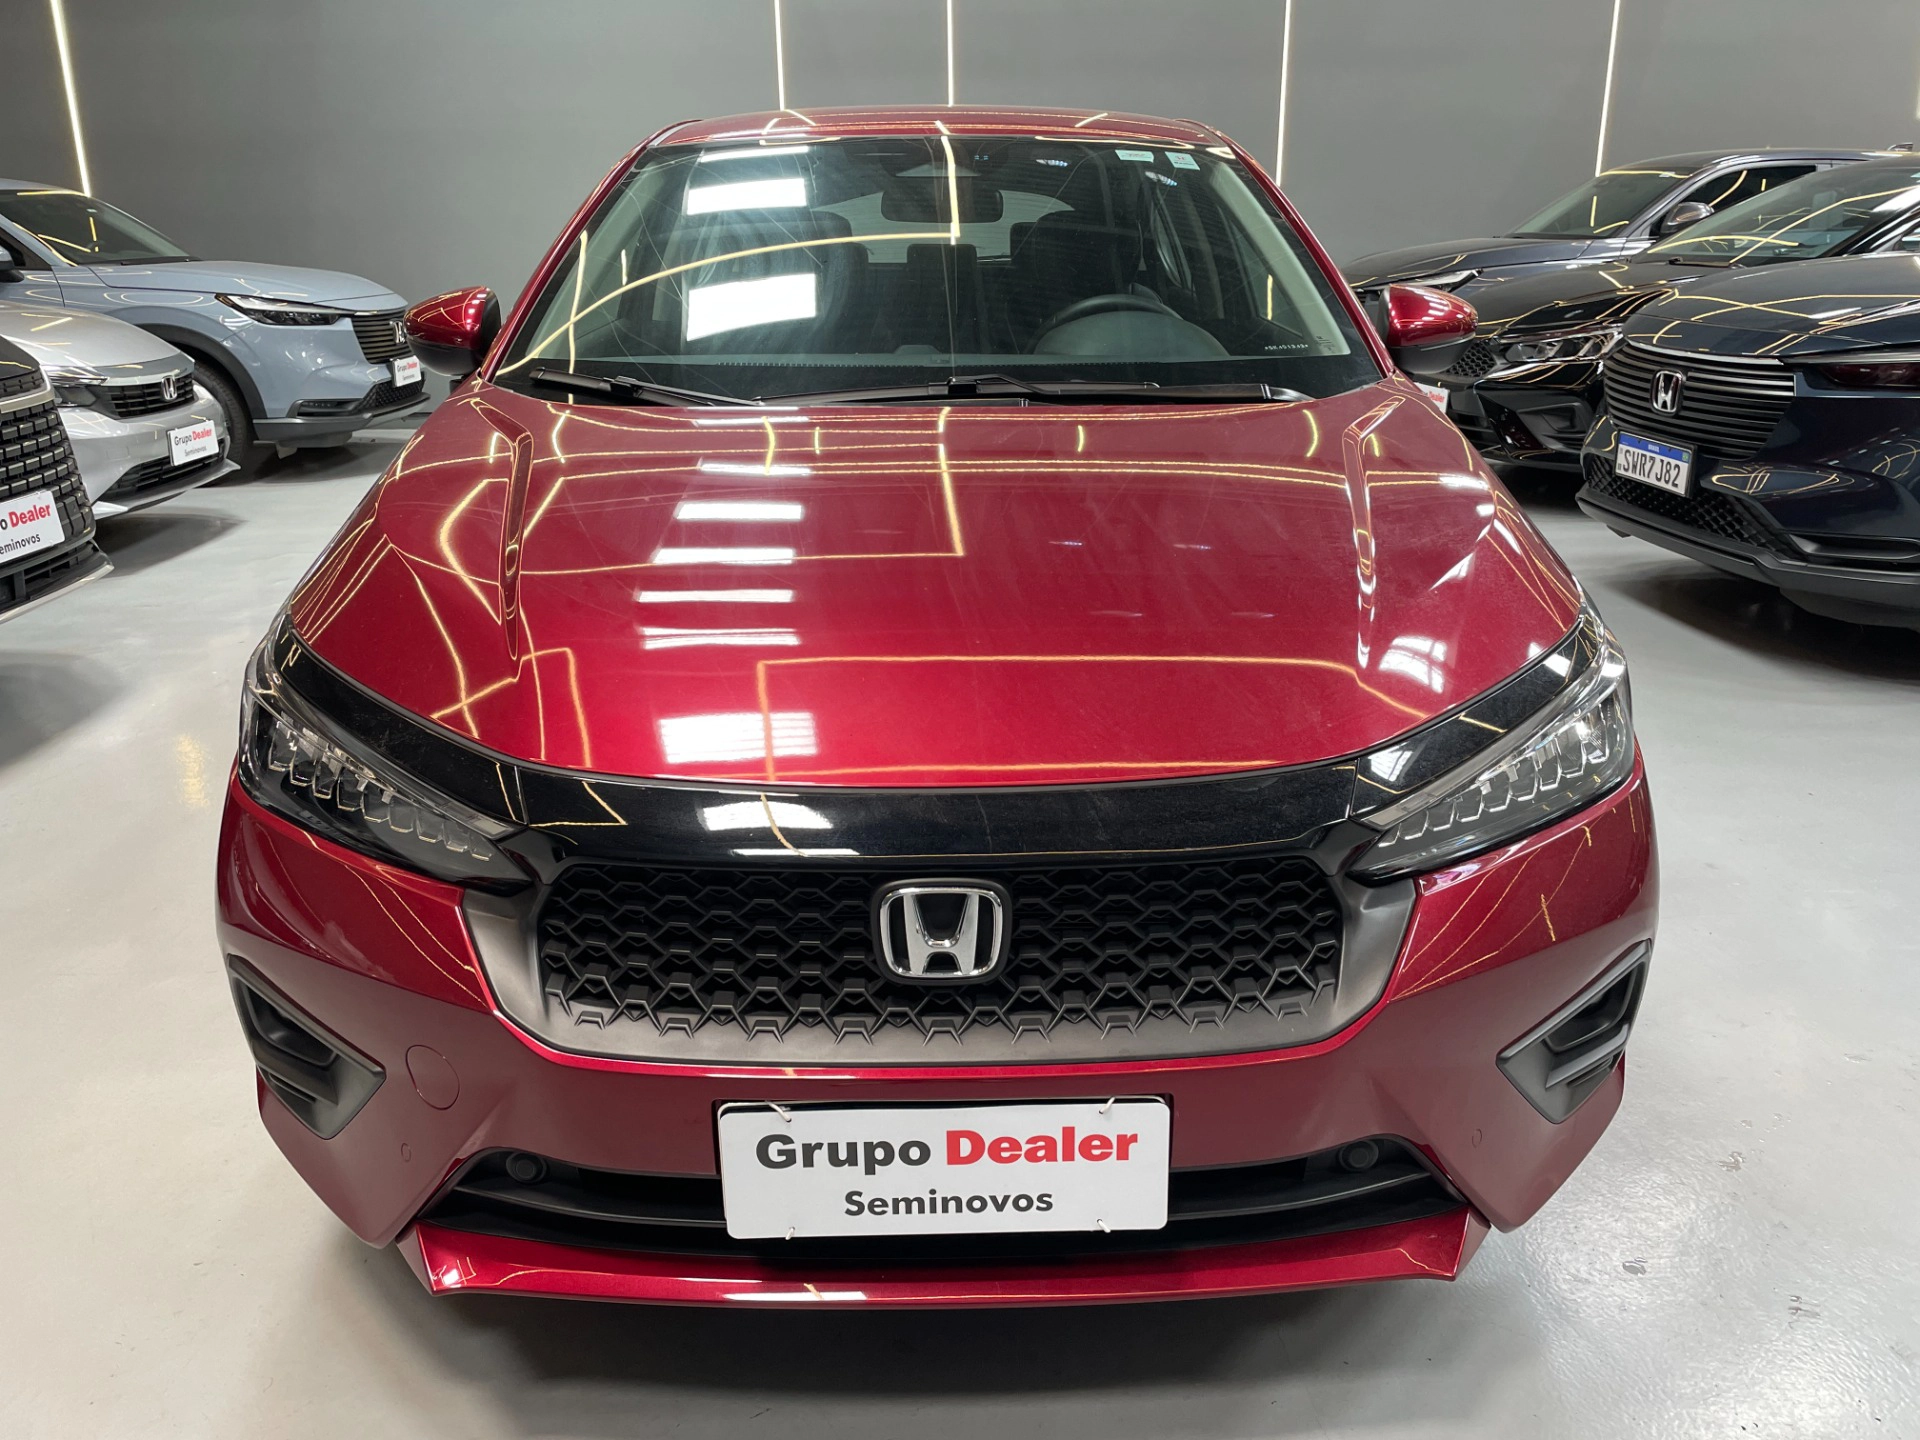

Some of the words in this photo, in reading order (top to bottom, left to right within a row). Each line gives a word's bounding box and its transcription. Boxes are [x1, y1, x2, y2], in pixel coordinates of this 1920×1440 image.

[174, 434, 192, 446] Grupo
[192, 427, 212, 440] Dealer
[1623, 449, 1681, 488] SWR7J82
[8, 504, 51, 528] Dealer
[0, 534, 41, 555] eminovos
[755, 1134, 931, 1175] Grupo
[946, 1126, 1138, 1165] Dealer
[844, 1188, 1053, 1216] Seminovos
